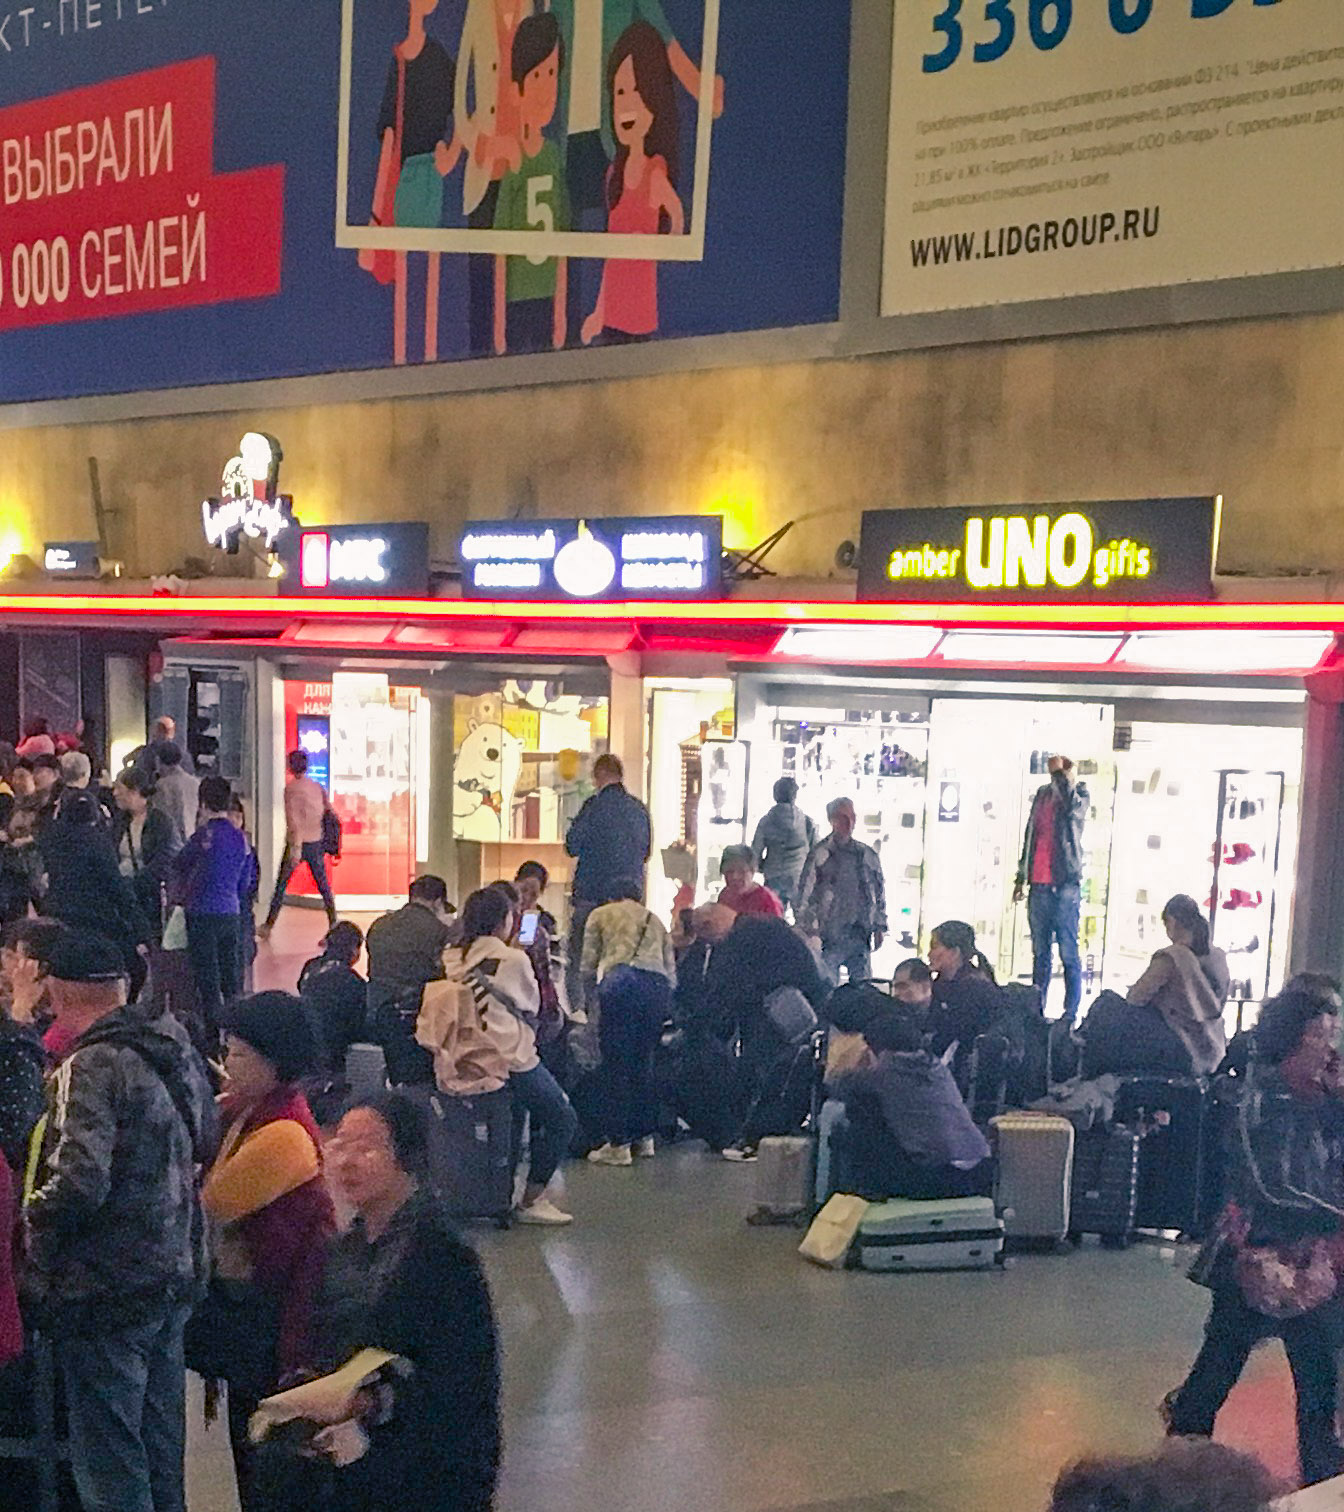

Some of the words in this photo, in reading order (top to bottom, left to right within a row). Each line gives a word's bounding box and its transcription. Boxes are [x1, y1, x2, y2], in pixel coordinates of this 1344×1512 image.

[3, 102, 174, 206] ВЫБРАЛИ
[11, 235, 70, 310] 000
[79, 193, 208, 299] СЕМЕЙ
[910, 206, 1160, 268] WWW.LIDGROUP.RU
[887, 542, 962, 582] amber
[963, 511, 1094, 590] UNO
[1093, 537, 1152, 589] gifts
